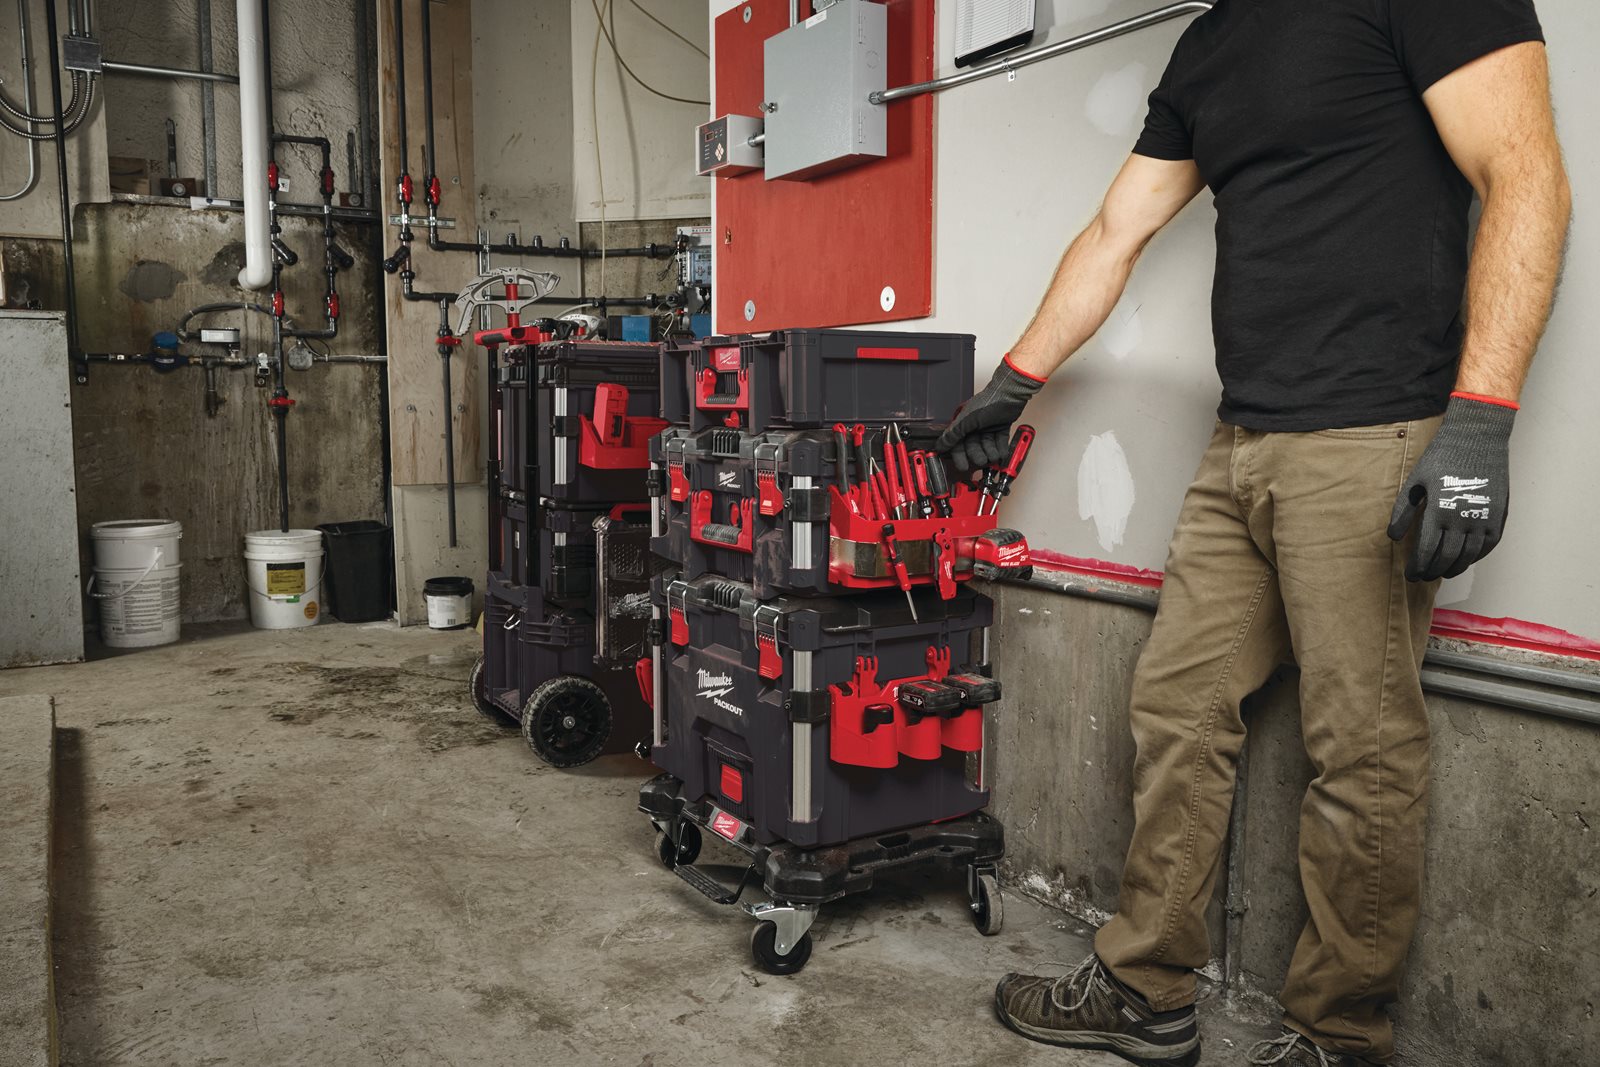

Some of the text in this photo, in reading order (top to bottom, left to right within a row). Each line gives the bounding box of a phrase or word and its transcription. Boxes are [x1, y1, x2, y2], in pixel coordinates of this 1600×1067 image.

[1440, 475, 1489, 487] Milwaukee
[999, 544, 1025, 558] Milwaukee
[696, 667, 733, 690] Milwaukee
[713, 697, 744, 717] PACKOUT
